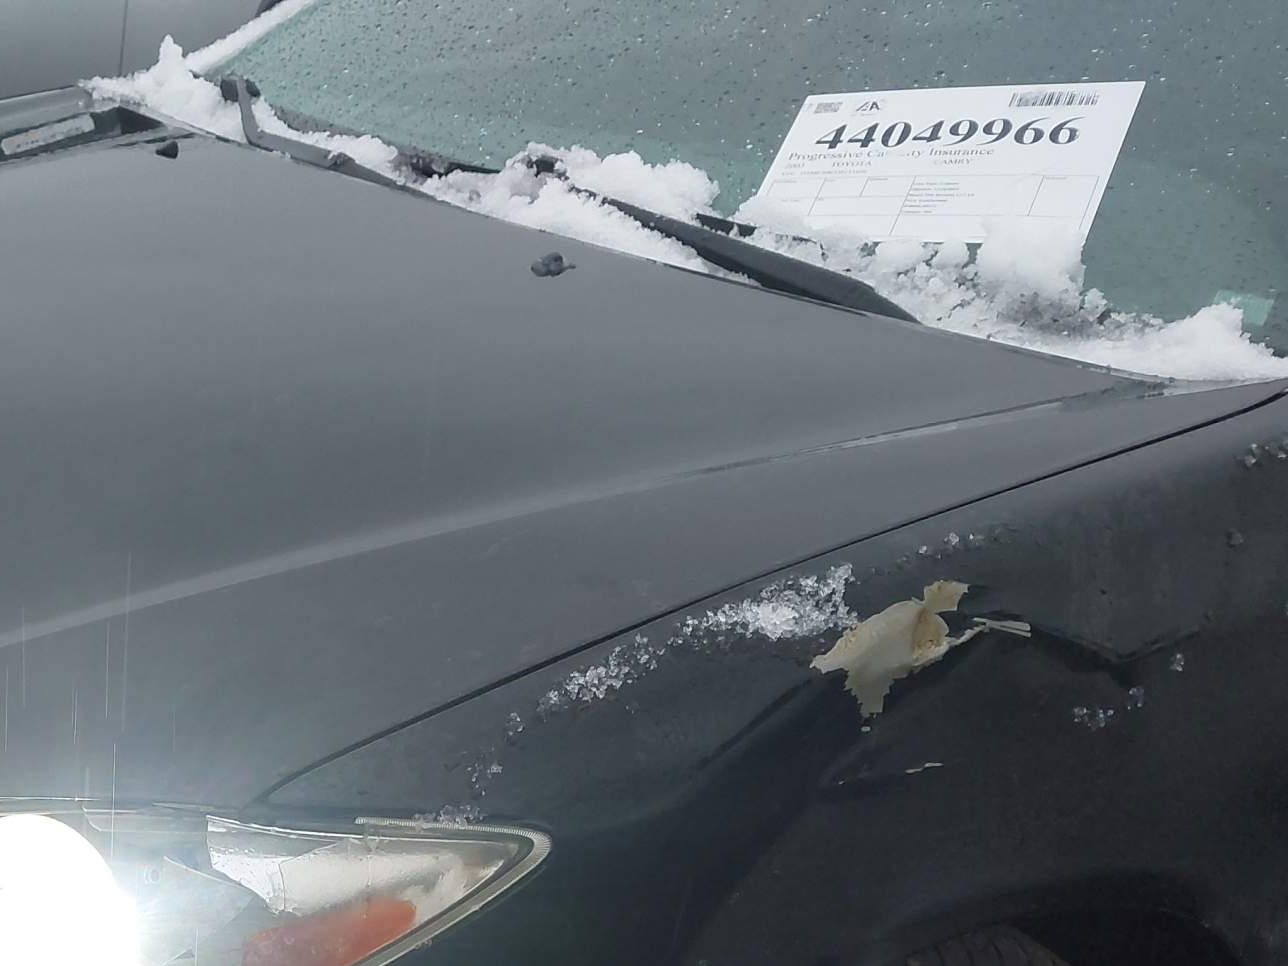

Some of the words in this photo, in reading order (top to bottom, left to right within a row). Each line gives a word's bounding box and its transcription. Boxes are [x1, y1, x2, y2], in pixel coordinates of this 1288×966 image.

[815, 116, 1087, 150] 44049966
[788, 150, 861, 162] Progressive
[867, 148, 922, 159] Caty
[929, 147, 995, 157] Insurance
